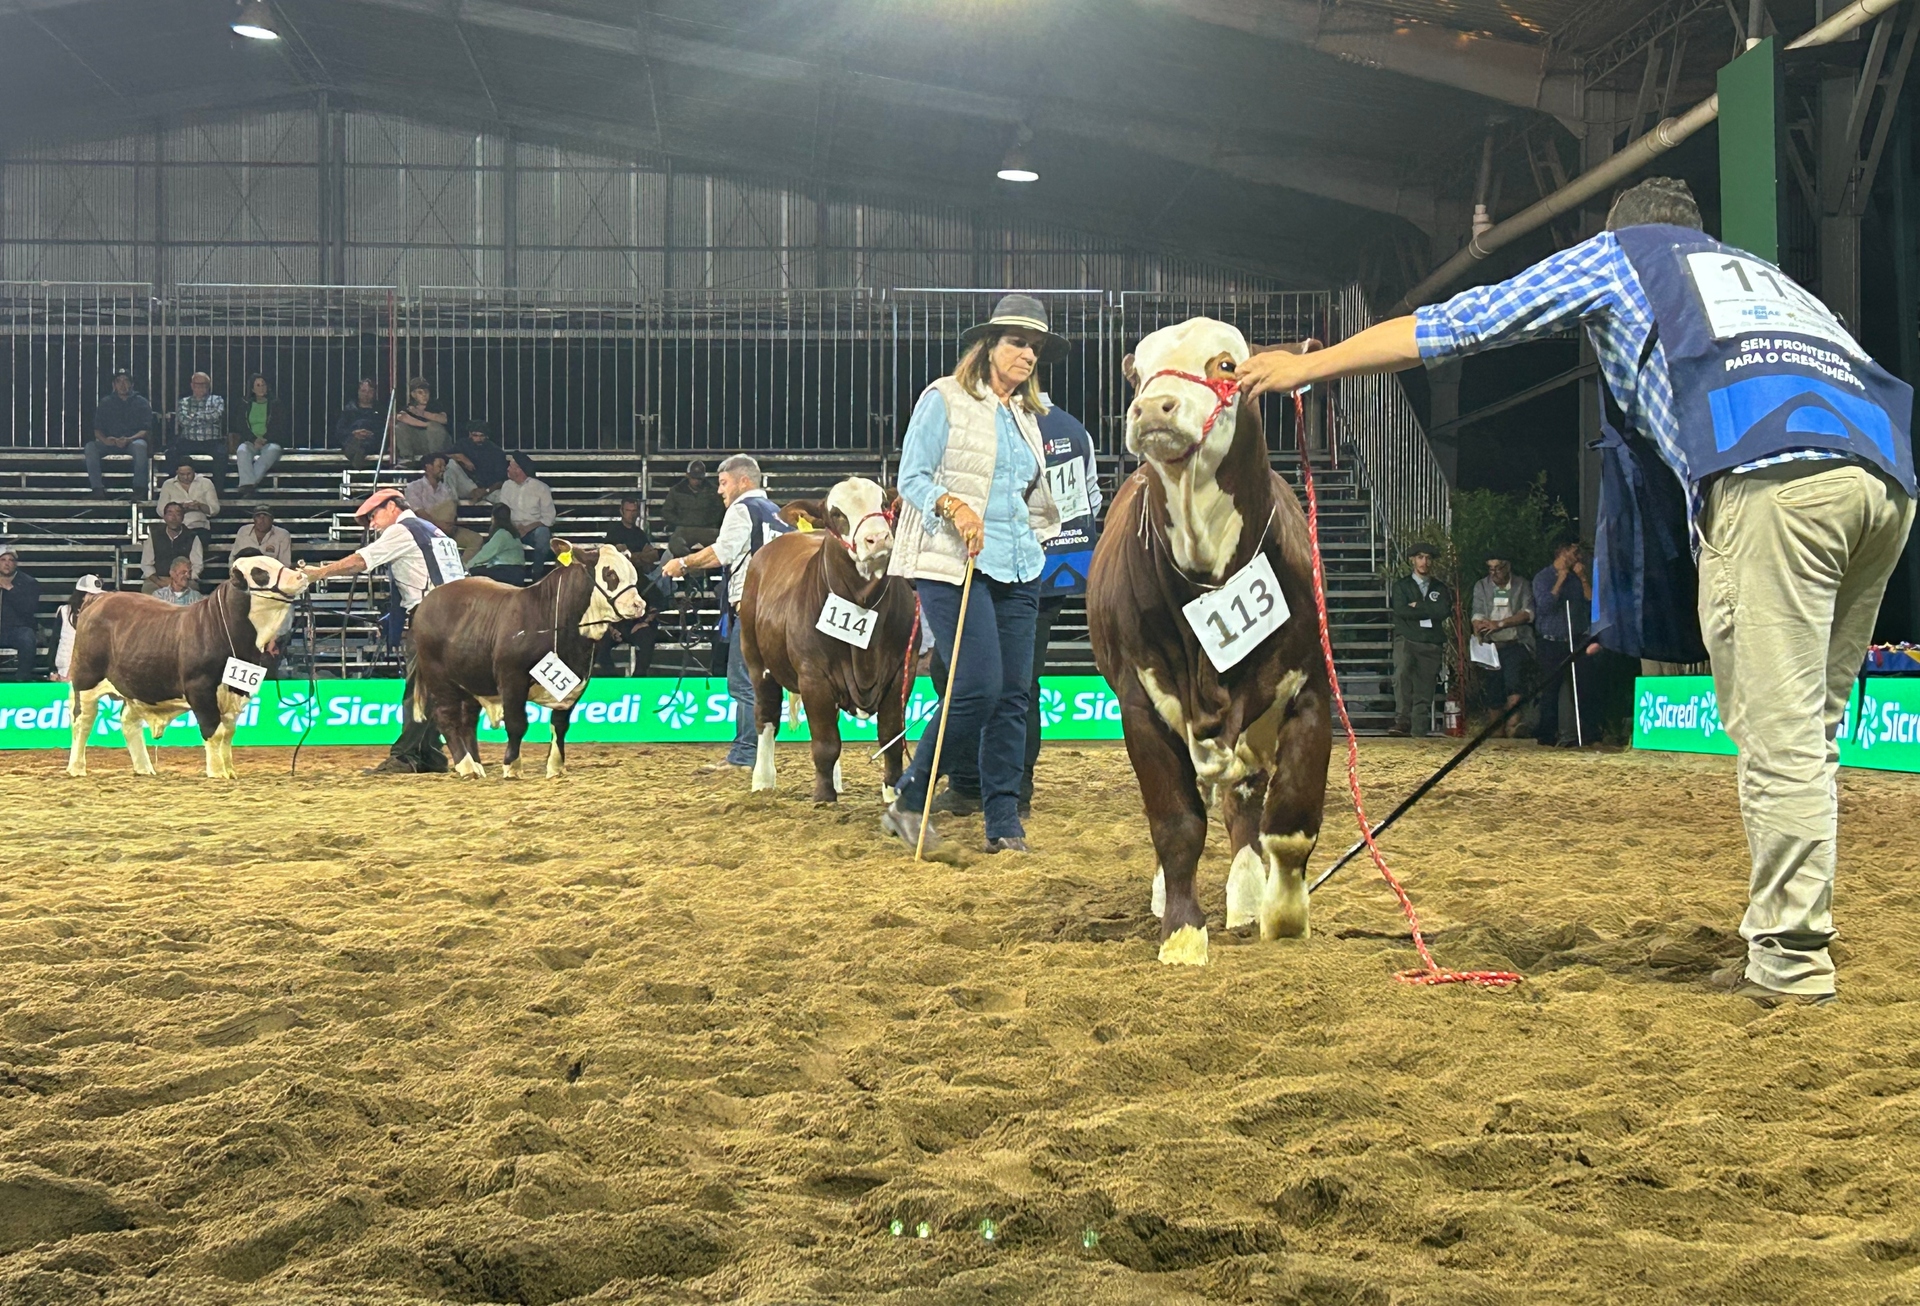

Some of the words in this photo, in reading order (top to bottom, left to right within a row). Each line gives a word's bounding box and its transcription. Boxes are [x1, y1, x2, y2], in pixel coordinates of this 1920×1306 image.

[1741, 338, 1771, 353] SEM
[1725, 351, 1764, 372] PARA
[1766, 352, 1779, 364] O
[1781, 351, 1866, 391] CRESCIMENT
[826, 606, 867, 637] 114
[1206, 578, 1274, 649] 113
[227, 665, 260, 686] 116
[538, 661, 572, 692] 115
[0, 699, 71, 730] redi
[1654, 695, 1698, 729] Sicredi
